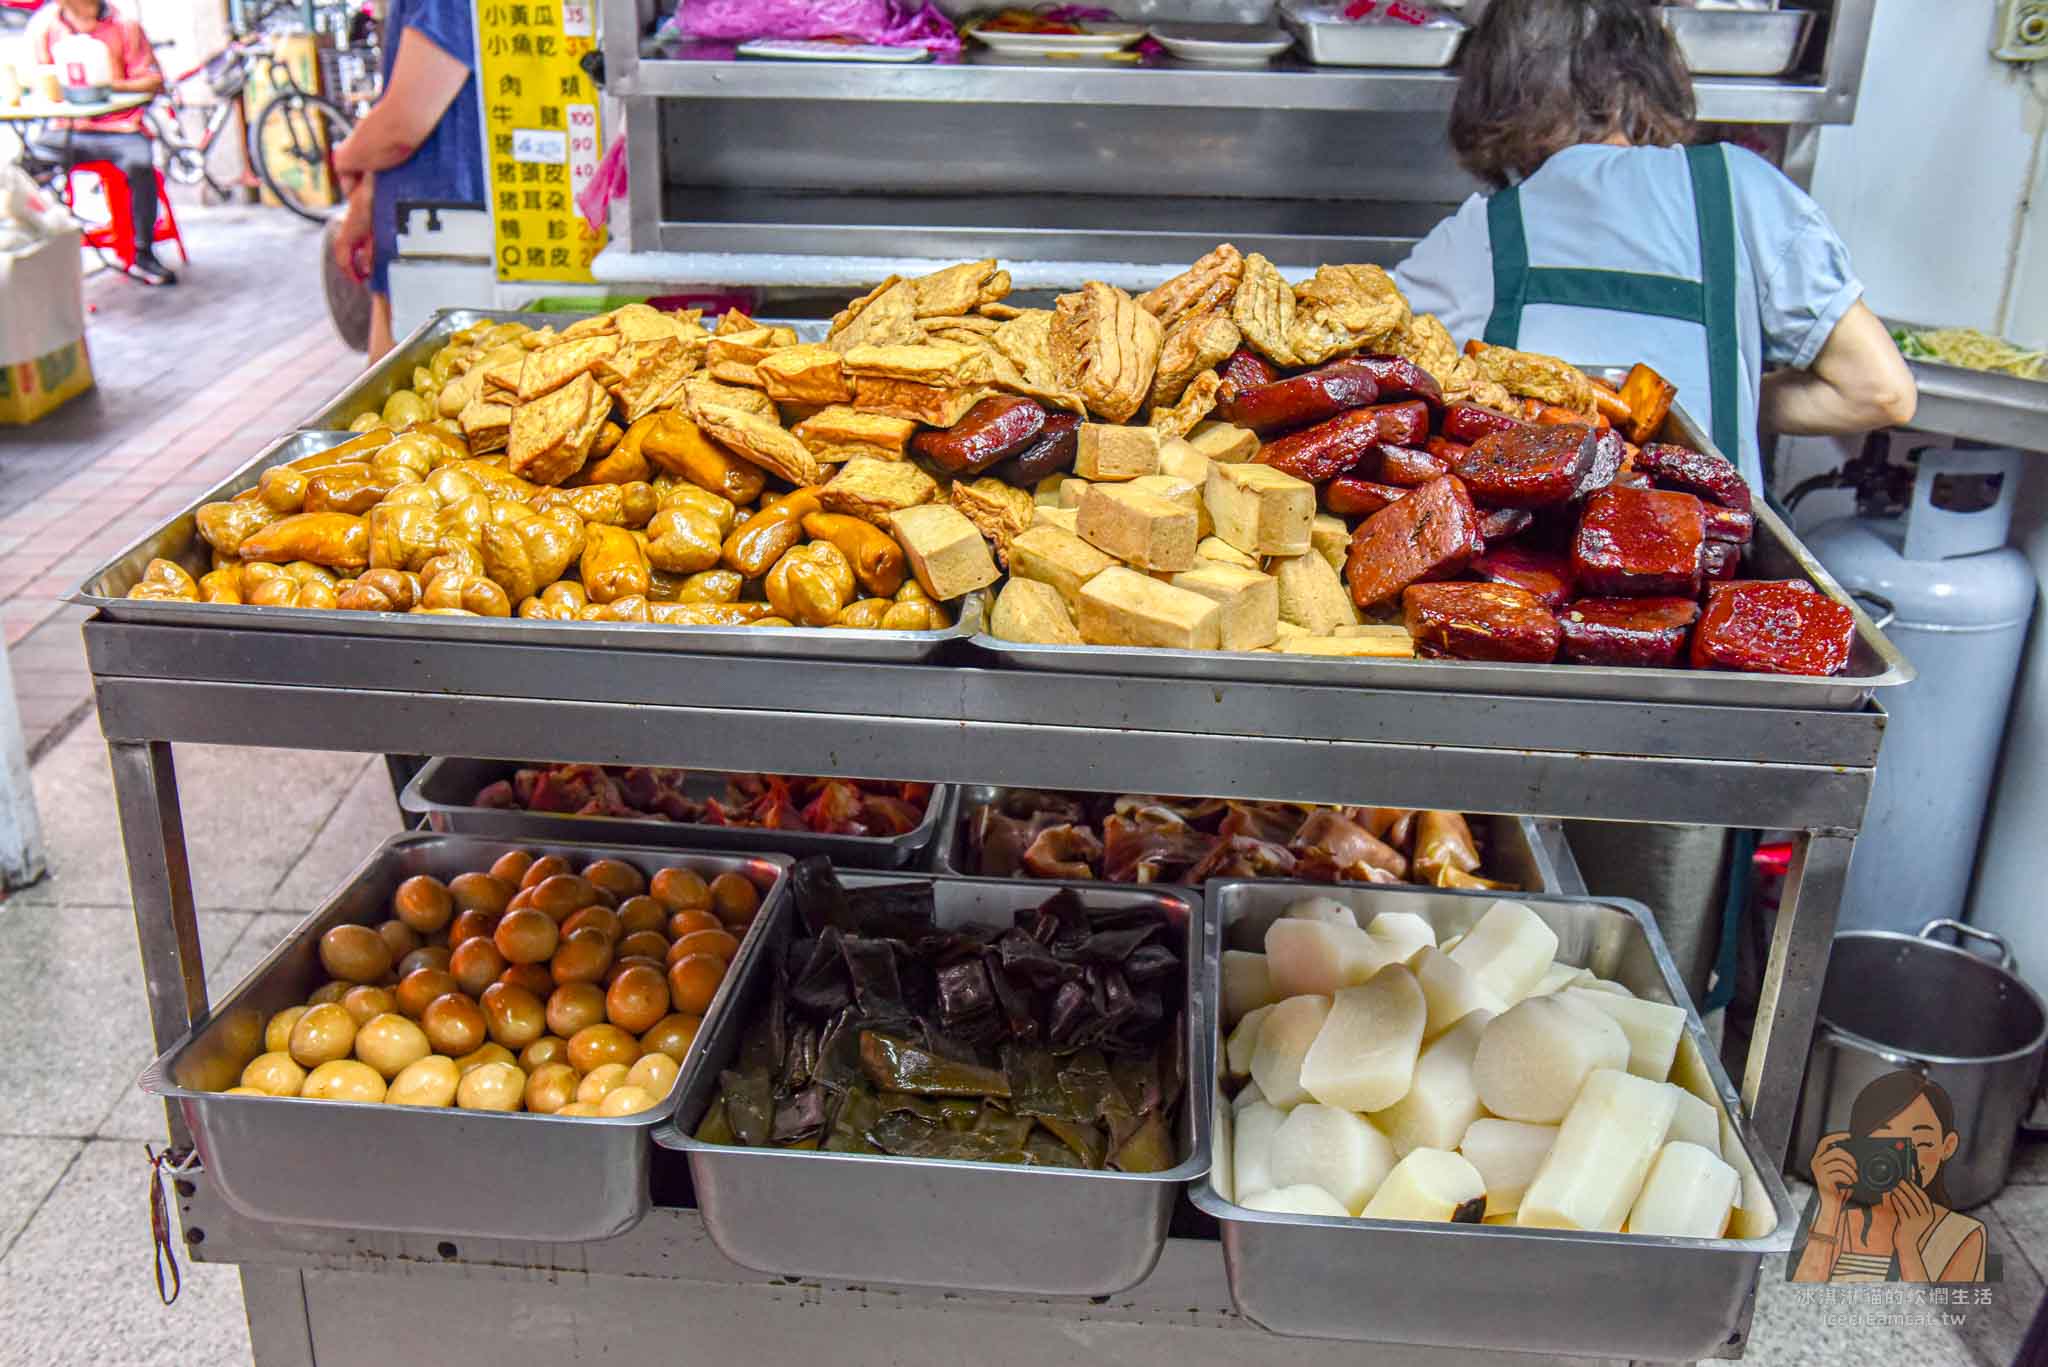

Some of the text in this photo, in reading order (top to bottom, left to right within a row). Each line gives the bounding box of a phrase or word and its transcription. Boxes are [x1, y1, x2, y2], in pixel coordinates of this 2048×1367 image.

[485, 5, 554, 26] 小黃瓜
[487, 34, 557, 56] 小魚乾
[572, 111, 594, 126] 100
